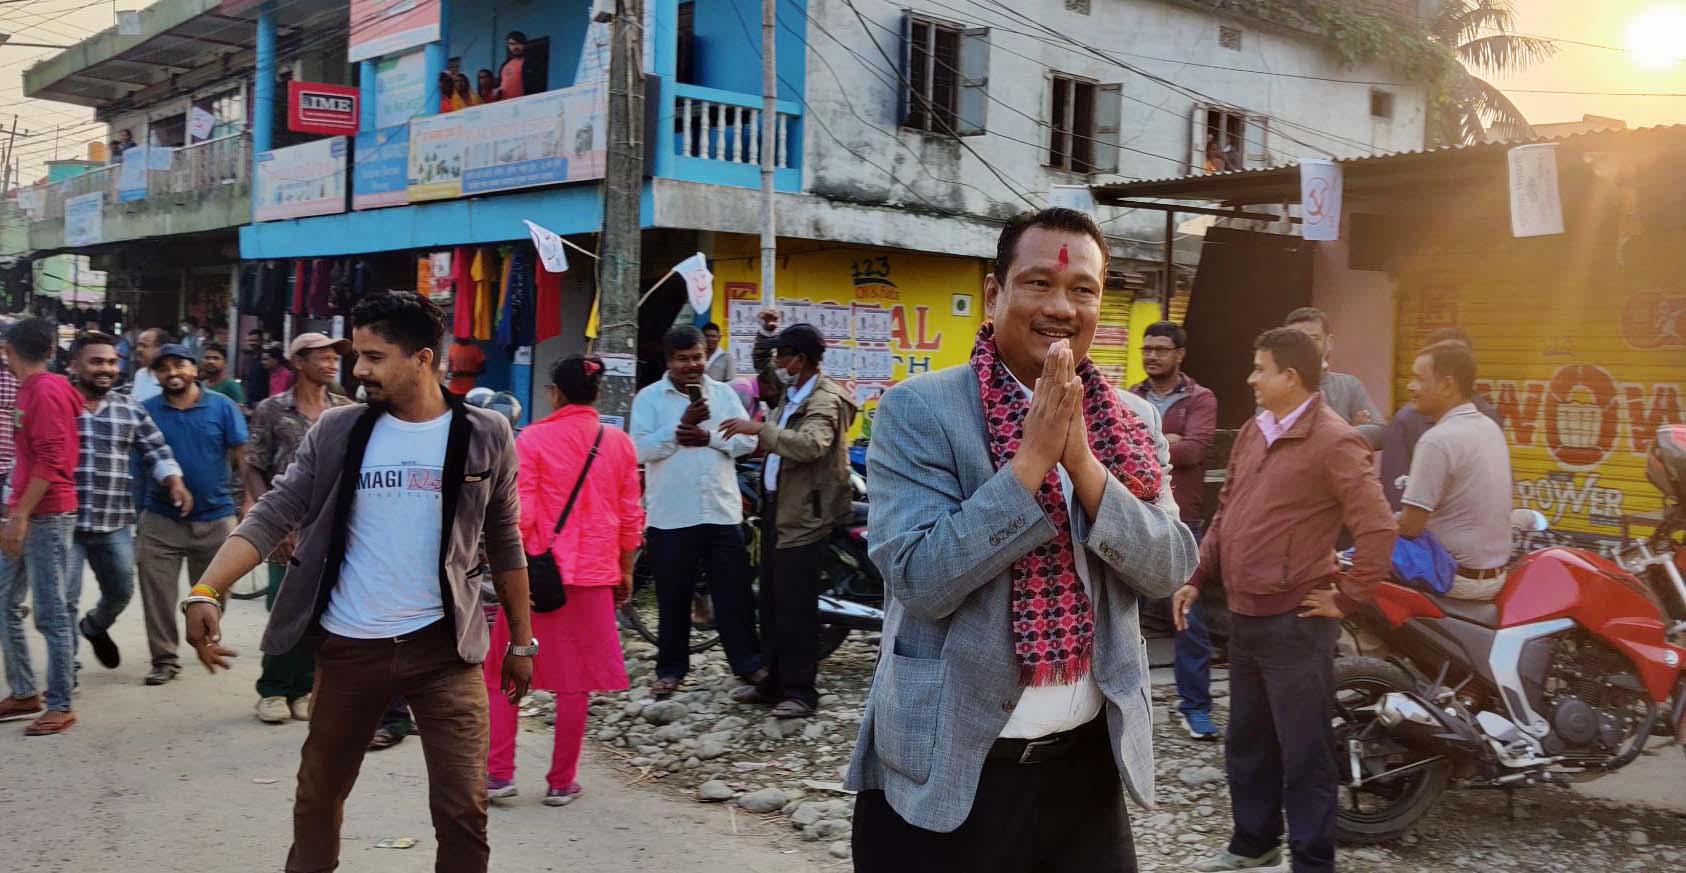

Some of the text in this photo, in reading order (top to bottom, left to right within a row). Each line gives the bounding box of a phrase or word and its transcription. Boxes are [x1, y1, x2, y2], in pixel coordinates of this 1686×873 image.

[309, 95, 352, 112] IME
[851, 255, 890, 277] 123
[1517, 473, 1623, 522] POWER
